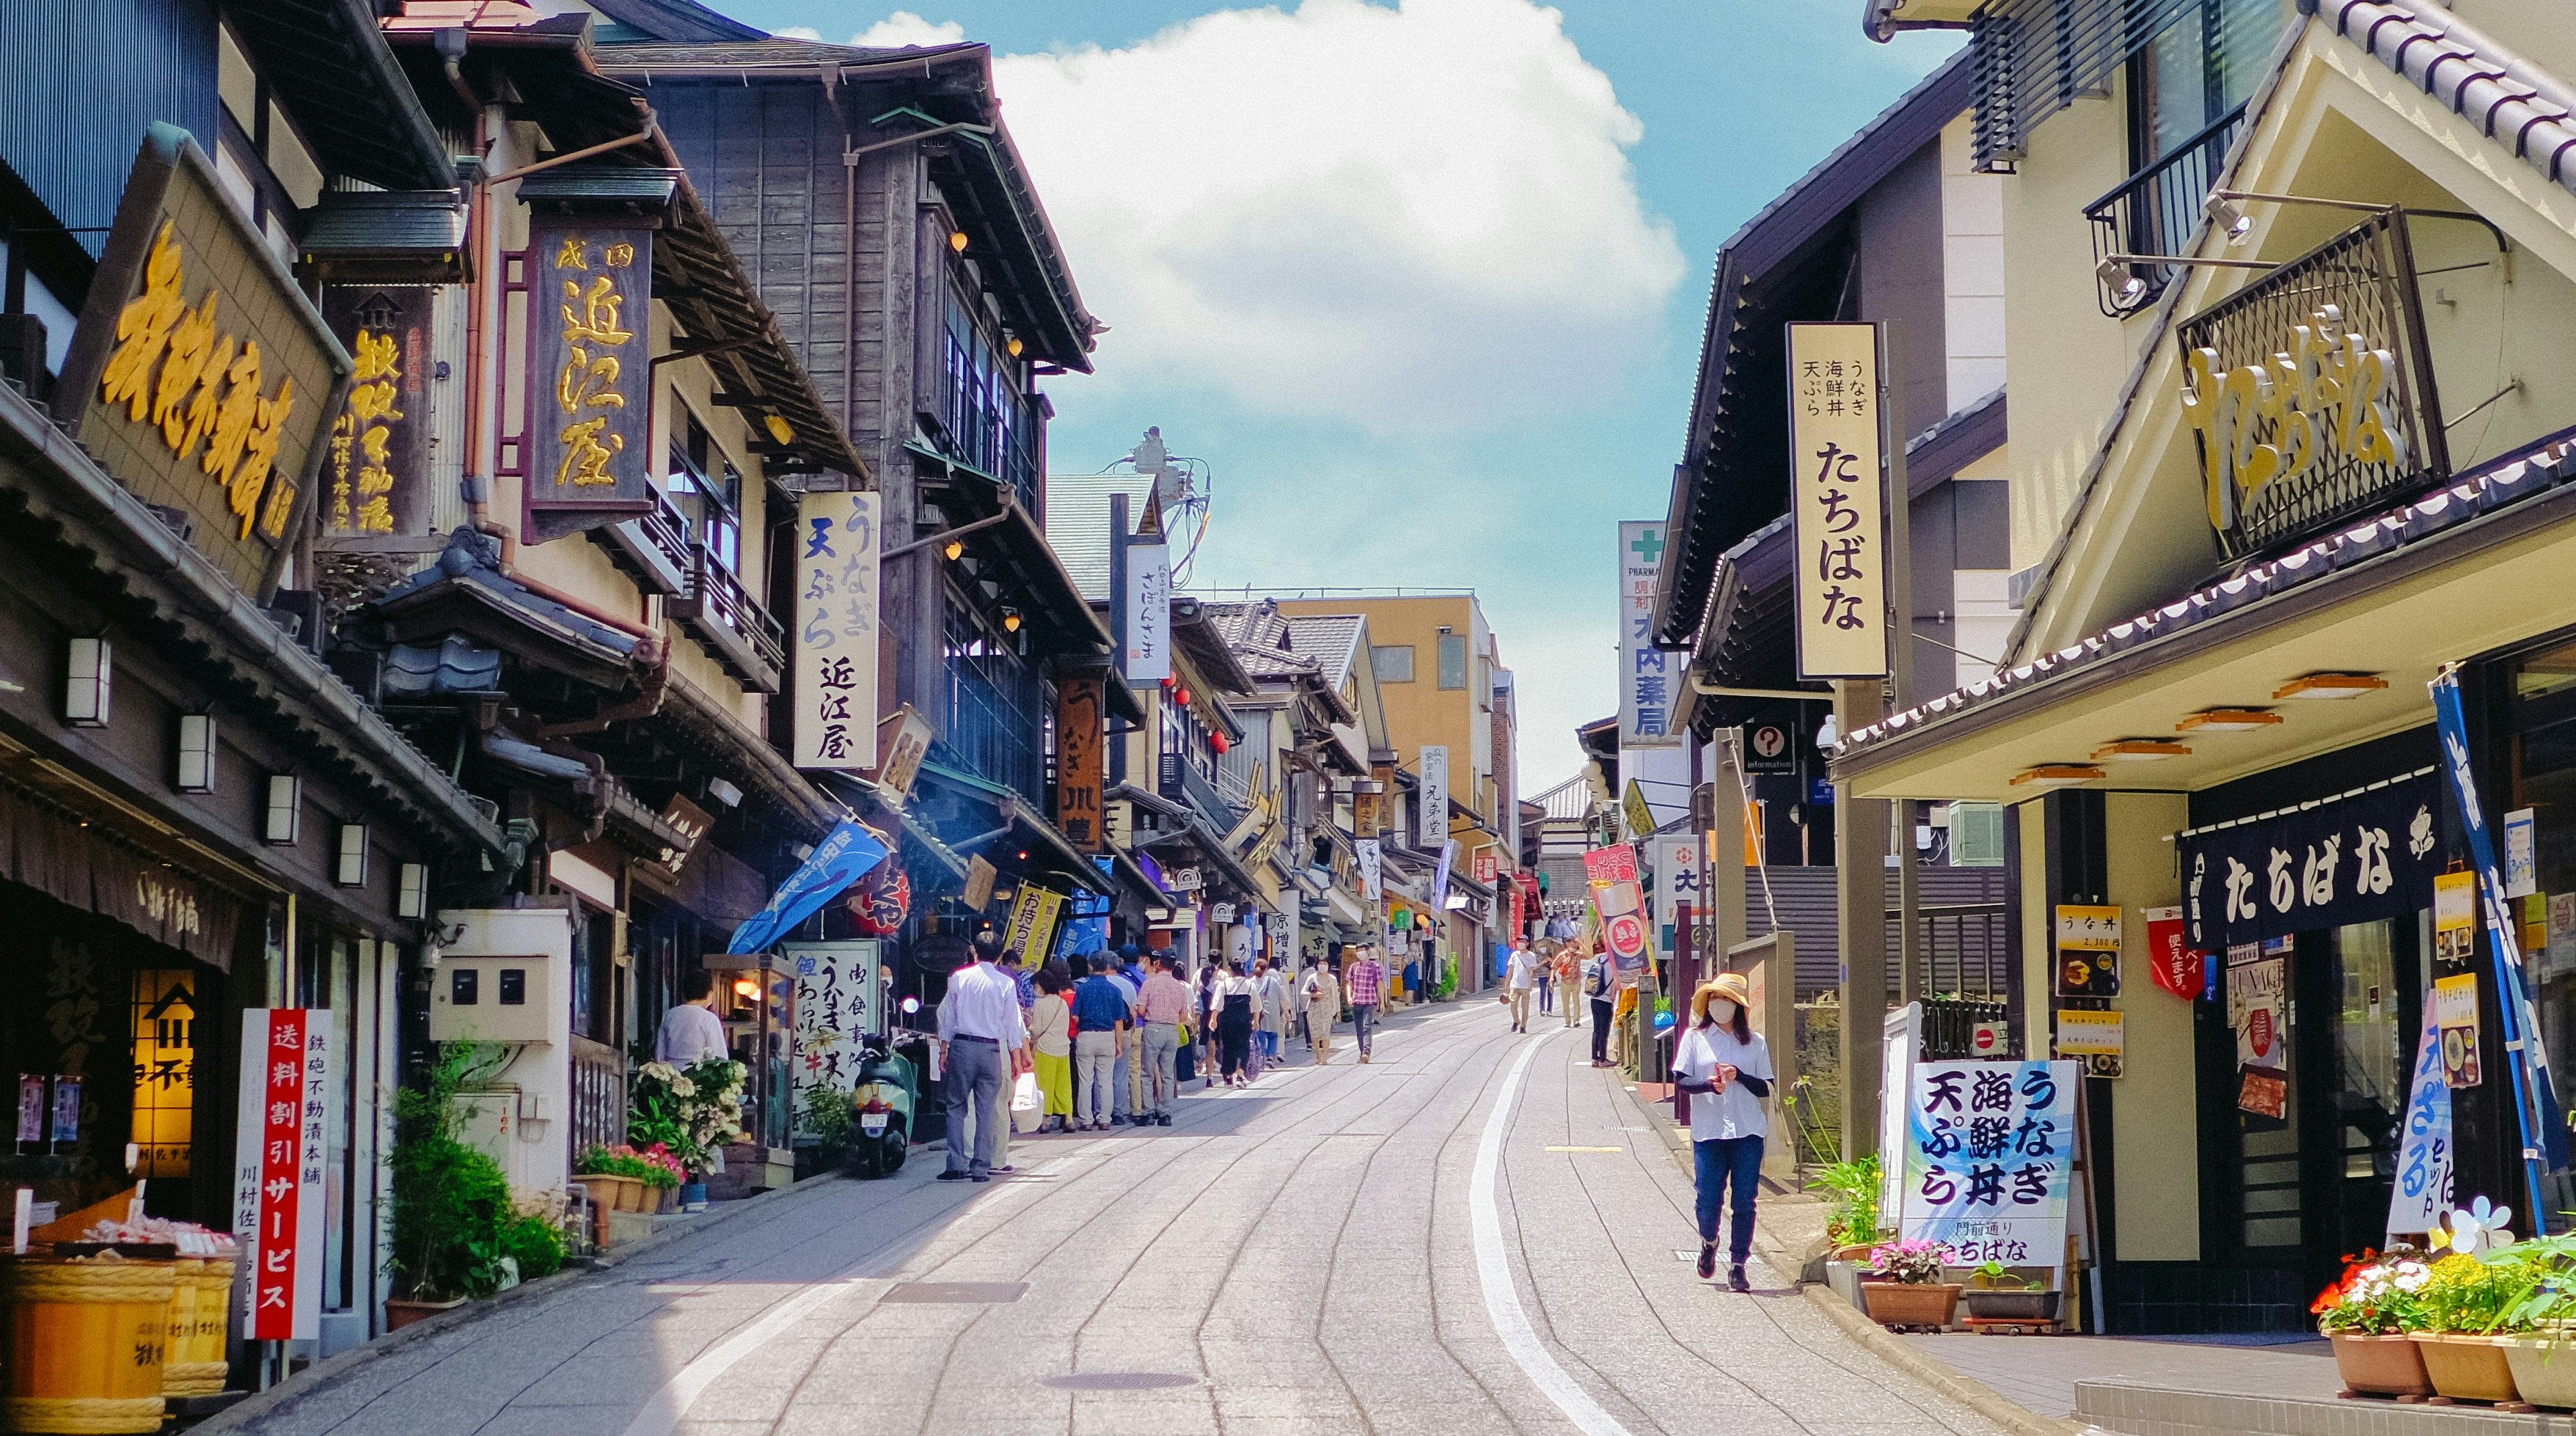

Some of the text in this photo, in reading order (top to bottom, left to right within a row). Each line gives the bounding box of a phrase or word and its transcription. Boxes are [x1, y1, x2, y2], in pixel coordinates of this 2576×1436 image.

[556, 275, 634, 486] 近江屋
[1803, 360, 1821, 417] 天ぷら
[1825, 360, 1845, 417] 海鮮丼
[1849, 360, 1867, 417] うなぎ
[804, 517, 837, 651] 天ぷら
[840, 495, 871, 637] うなぎ
[1816, 442, 1866, 631] たちばな
[817, 656, 858, 759] 近江屋
[1747, 760, 1792, 769] information
[2065, 915, 2117, 932] うな丼
[2225, 825, 2393, 923] たちばな
[818, 956, 846, 1033] うなぎ
[2168, 934, 2187, 990] 使えます。
[303, 1034, 326, 1185] 鉄砲不動漬本舗
[1920, 1070, 1966, 1205] 天ぷら
[1966, 1070, 2013, 1206] 海鮮丼
[2012, 1070, 2057, 1205] うなぎ
[259, 1024, 300, 1309] 送料割引サービス
[2423, 1138, 2445, 1218] セット
[1955, 1221, 2013, 1237] 門前通り
